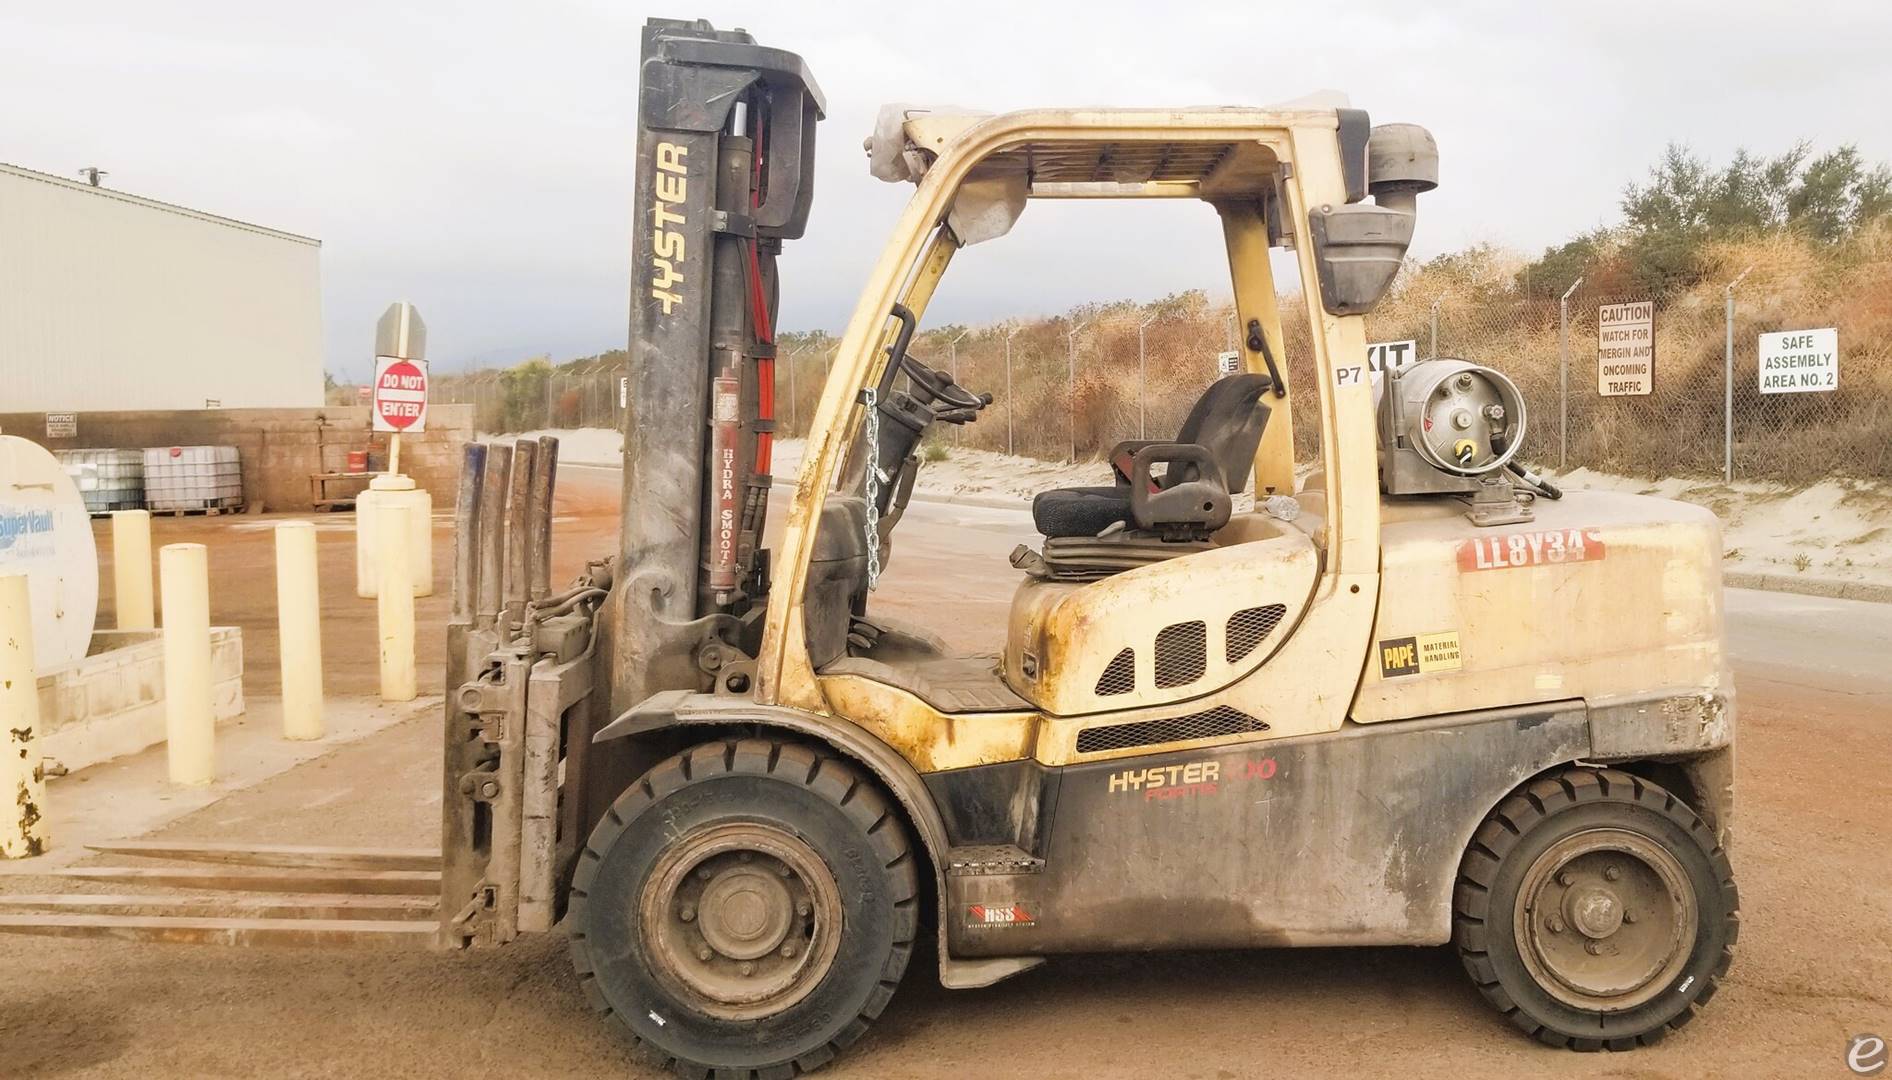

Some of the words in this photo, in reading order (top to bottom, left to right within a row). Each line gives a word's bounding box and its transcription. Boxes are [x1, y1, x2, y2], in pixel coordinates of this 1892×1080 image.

[1601, 305, 1650, 323] CAUTION
[1602, 330, 1630, 342] WATCH
[1632, 328, 1649, 340] FOR
[1782, 335, 1814, 350] SAFE
[1600, 347, 1631, 360] MERGIN
[1633, 346, 1650, 358] AND
[1765, 353, 1832, 370] ASSEMBLY
[1336, 366, 1361, 385] P7
[1603, 363, 1647, 376] ONCOMING
[383, 373, 399, 388] DO
[400, 375, 423, 390] NOT
[1608, 381, 1641, 393] TRAFFIC
[1763, 374, 1796, 389] AREA
[1800, 373, 1822, 387] NO.
[1826, 372, 1834, 385] 2
[382, 402, 420, 417] ENTER
[722, 449, 734, 500] HYDRA
[1423, 640, 1458, 652] MATERIAL
[1424, 651, 1460, 663] HANDLING
[1108, 761, 1220, 793] HYSTER
